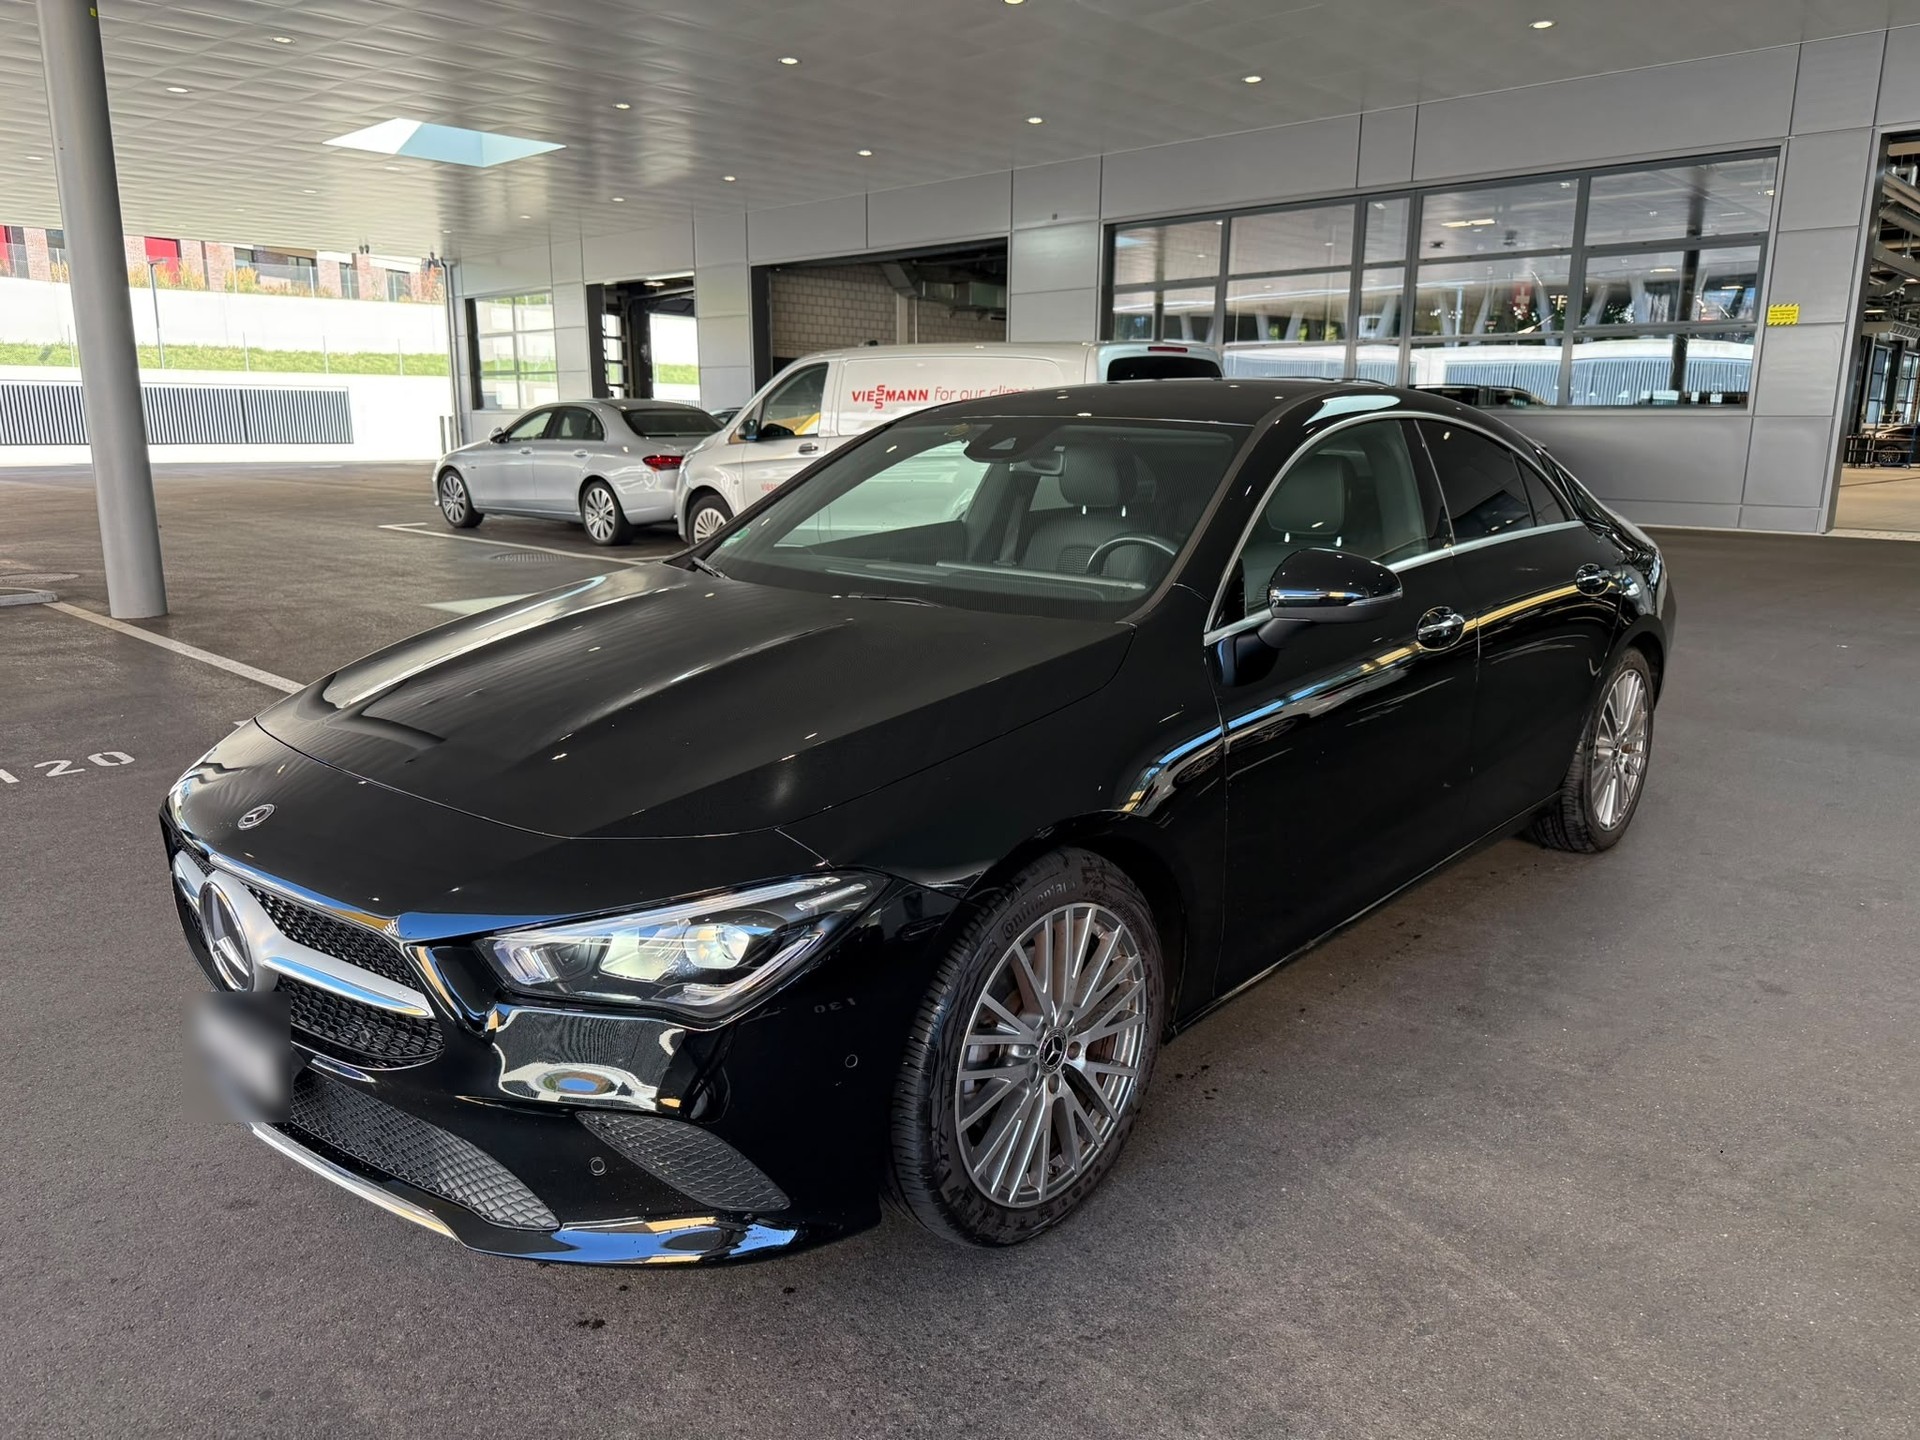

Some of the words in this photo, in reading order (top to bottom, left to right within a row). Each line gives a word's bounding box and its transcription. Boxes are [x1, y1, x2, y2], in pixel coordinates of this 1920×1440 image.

[852, 384, 929, 409] VIESSMANN
[934, 386, 957, 402] for
[959, 389, 986, 400] our
